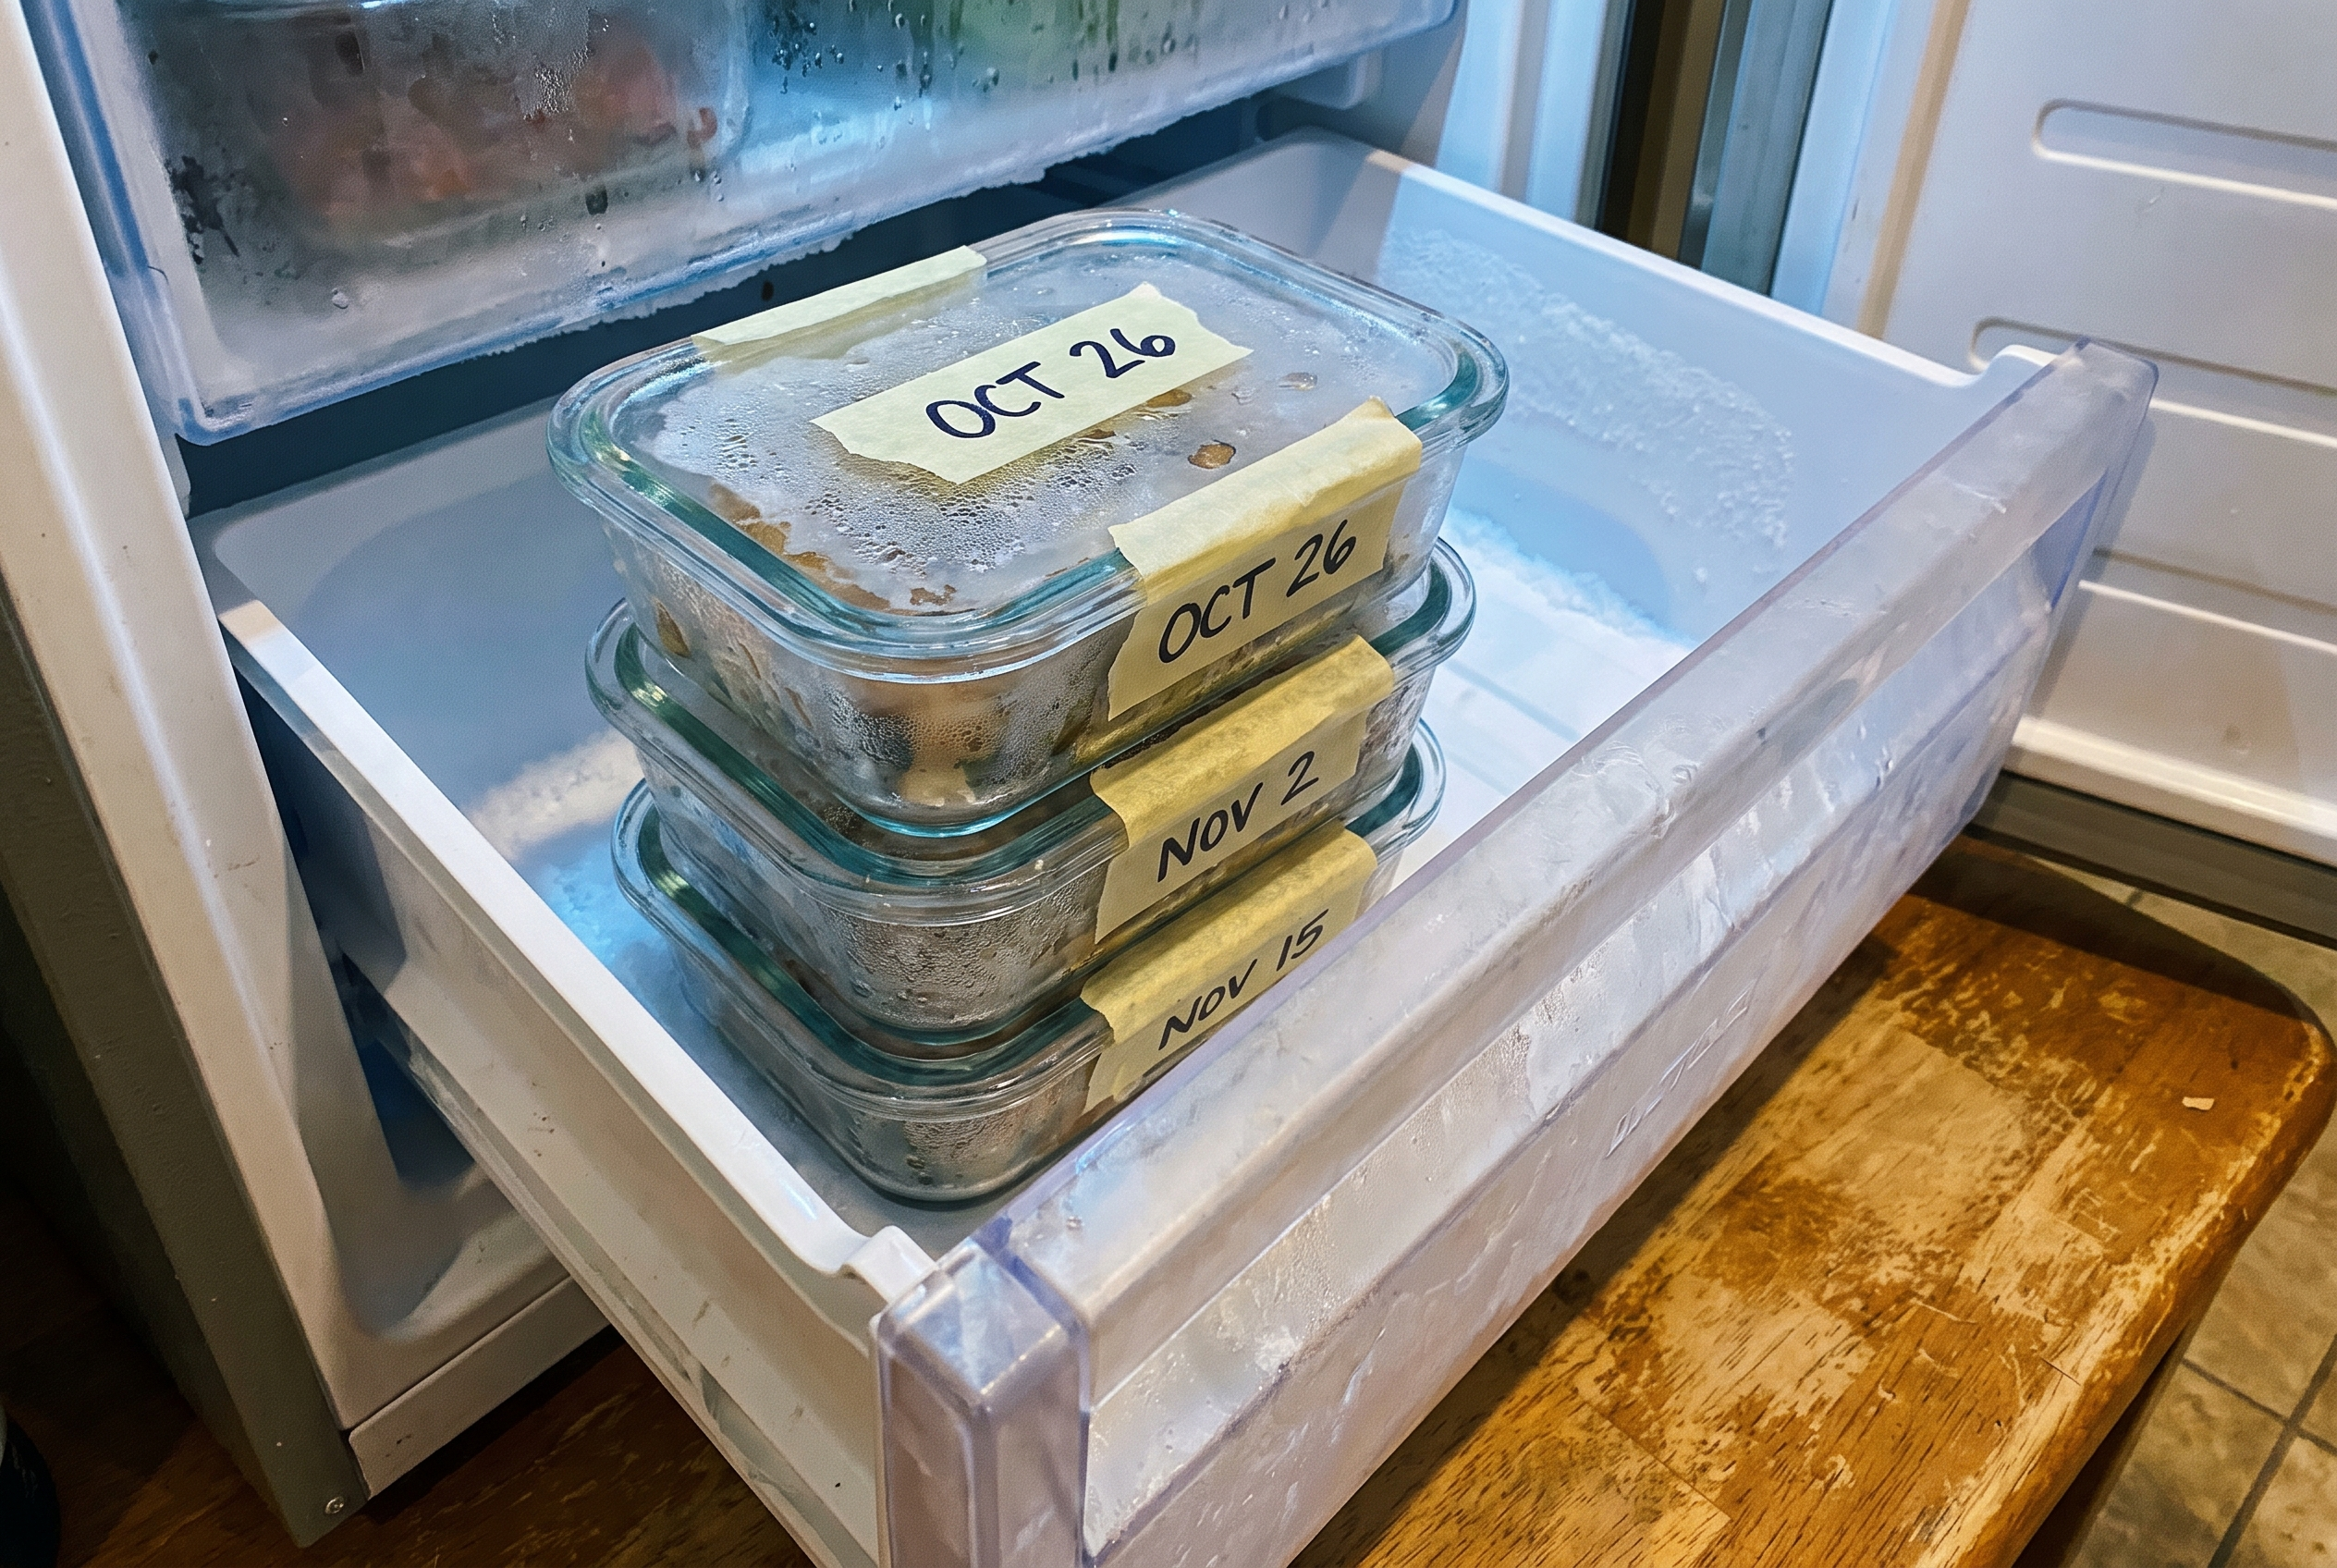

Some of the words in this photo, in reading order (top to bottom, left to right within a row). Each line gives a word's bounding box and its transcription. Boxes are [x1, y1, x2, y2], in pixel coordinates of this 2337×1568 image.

[925, 361, 1065, 438] OCT
[1070, 328, 1176, 378] 26
[1158, 557, 1276, 664] OCT
[1286, 520, 1357, 598] 26
[1157, 782, 1264, 883] NOV
[1280, 751, 1319, 805] 2
[1158, 959, 1258, 1051] NOV
[1277, 909, 1329, 972] 15
